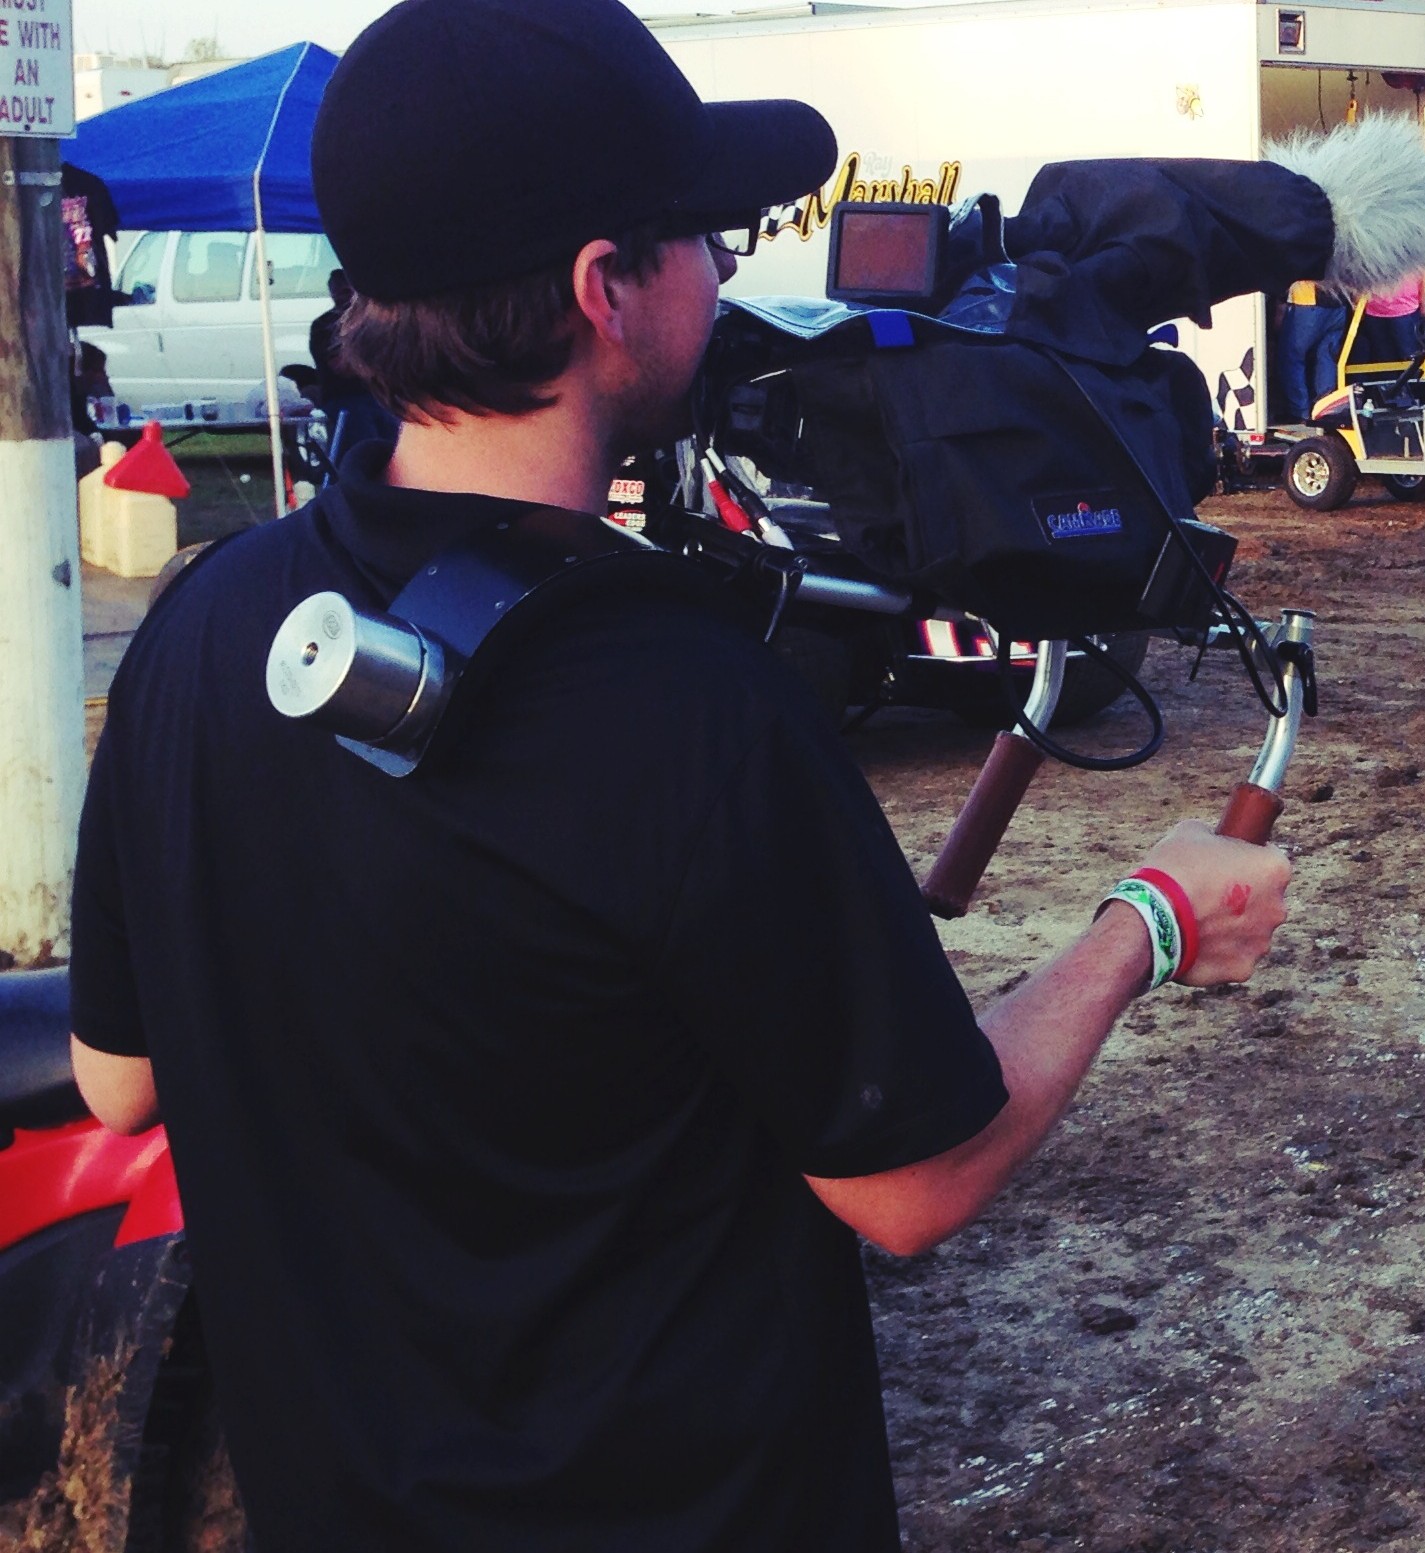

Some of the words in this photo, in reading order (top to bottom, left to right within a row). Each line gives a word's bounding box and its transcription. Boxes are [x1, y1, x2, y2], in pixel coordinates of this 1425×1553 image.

[18, 20, 60, 50] WITH
[14, 58, 39, 86] AN
[0, 95, 55, 124] ADULT
[863, 151, 894, 178] Ray
[799, 152, 961, 242] Marshall
[610, 480, 644, 494] OXCO
